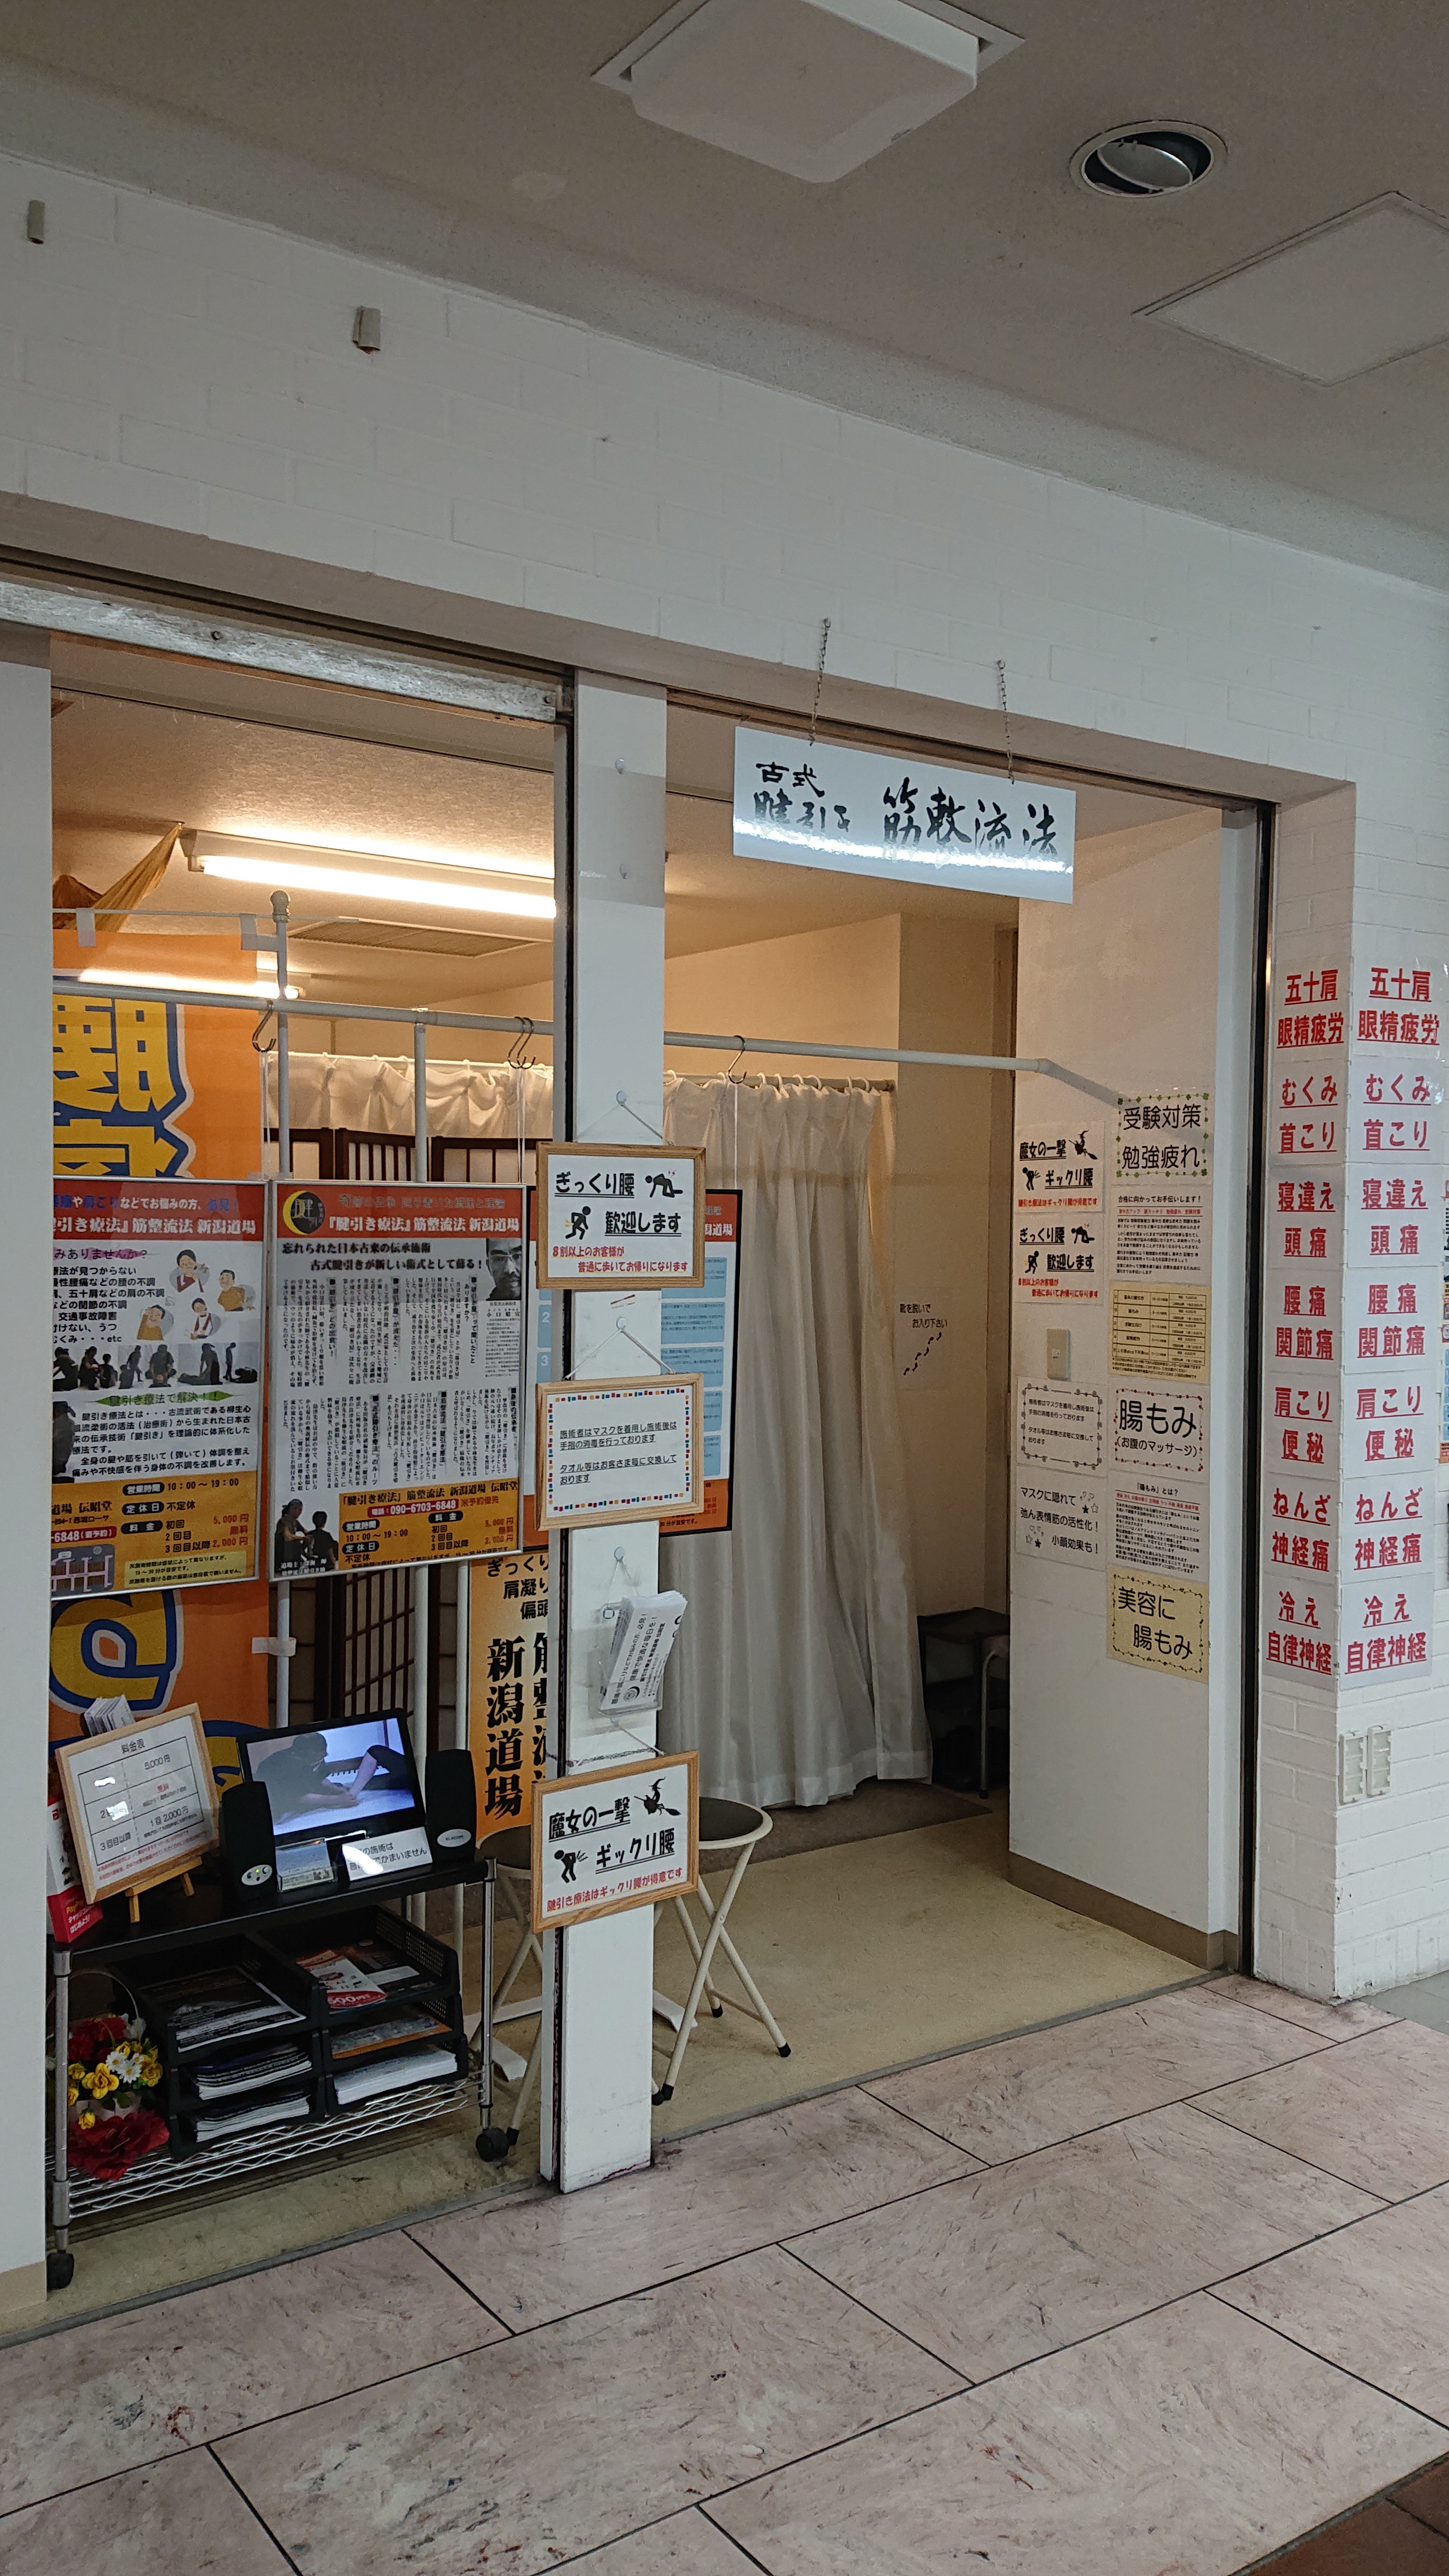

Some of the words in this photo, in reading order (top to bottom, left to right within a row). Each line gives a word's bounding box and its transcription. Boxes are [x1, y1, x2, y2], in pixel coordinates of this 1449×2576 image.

[756, 761, 825, 798] 古式
[1285, 970, 1338, 1000] 五十肩
[1370, 968, 1430, 999] 五十肩
[1277, 1013, 1344, 1045] 眼精疲労
[1358, 1009, 1439, 1043] 眼精疲労
[1282, 1077, 1337, 1105] むくみ
[1366, 1074, 1430, 1102] むくみ
[1123, 1104, 1201, 1130] 受験対策
[1280, 1121, 1335, 1151] 首こり
[1364, 1119, 1427, 1149] 首こり
[1020, 1139, 1066, 1159] 魔女の一撃
[1122, 1145, 1200, 1169] 勉強疲れ
[556, 1171, 634, 1196] ぎっくり腰
[1045, 1168, 1093, 1186] ギックリ腰
[1278, 1181, 1334, 1210] 寝違え
[1362, 1178, 1426, 1208] 寝違え
[469, 1218, 519, 1232] 新潟道場
[606, 1211, 681, 1233] 歓迎します
[1019, 1227, 1065, 1242] ぎっくり腰
[552, 1246, 624, 1257] 8割以上のお客様が
[1284, 1227, 1326, 1256] 頭痛
[1371, 1224, 1419, 1253] 頭痛
[578, 1262, 688, 1272] 普通に歩いてお帰りになります
[1047, 1254, 1094, 1270] 歓迎します
[1284, 1285, 1325, 1314] 腰痛
[1368, 1283, 1417, 1313] 腰痛
[542, 1312, 549, 1322] 2
[912, 1318, 947, 1328] お入り下さい
[1276, 1327, 1333, 1358] 関節痛
[1358, 1325, 1425, 1356] 関節痛
[541, 1355, 548, 1367] 3
[1275, 1387, 1330, 1419] 肩こり
[1357, 1387, 1421, 1417] 肩こり
[560, 1421, 677, 1438] 施術者はマスクを着用し施術後は
[1119, 1399, 1197, 1438] 腸もみ
[560, 1434, 656, 1450] 手指の消毒を行っております
[1282, 1429, 1323, 1463] 便秘
[1365, 1429, 1414, 1459] 便秘
[560, 1454, 677, 1473] タオル等はお客さま毎に交換して
[560, 1474, 590, 1484] おります
[166, 1500, 195, 1512] 不定休
[1020, 1487, 1077, 1506] マスクに隠れて
[1273, 1488, 1330, 1523] ねんざ
[1357, 1488, 1422, 1521] ねんざ
[166, 1520, 184, 1529] 初回
[432, 1525, 448, 1534] 初回
[345, 1554, 370, 1563] 不定休
[1051, 1535, 1099, 1555] 小顔効果も！
[1273, 1532, 1329, 1571] 神経痛
[1355, 1533, 1421, 1570] 神経痛
[1118, 1587, 1175, 1620] 美容に
[1279, 1590, 1319, 1626] 冷え
[1364, 1594, 1409, 1626] 冷え
[1133, 1624, 1193, 1660] 腸もみ
[1268, 1631, 1331, 1674] 自律神経
[1347, 1632, 1426, 1672] 自律神経
[485, 1635, 525, 1820] 新潟道場
[121, 1738, 145, 1755] 料金表
[549, 1796, 630, 1839] 魔女の一撃
[596, 1828, 675, 1867] ギックリ腰
[547, 1867, 683, 1912] 腱引き療法はギックリ腰が得意です
